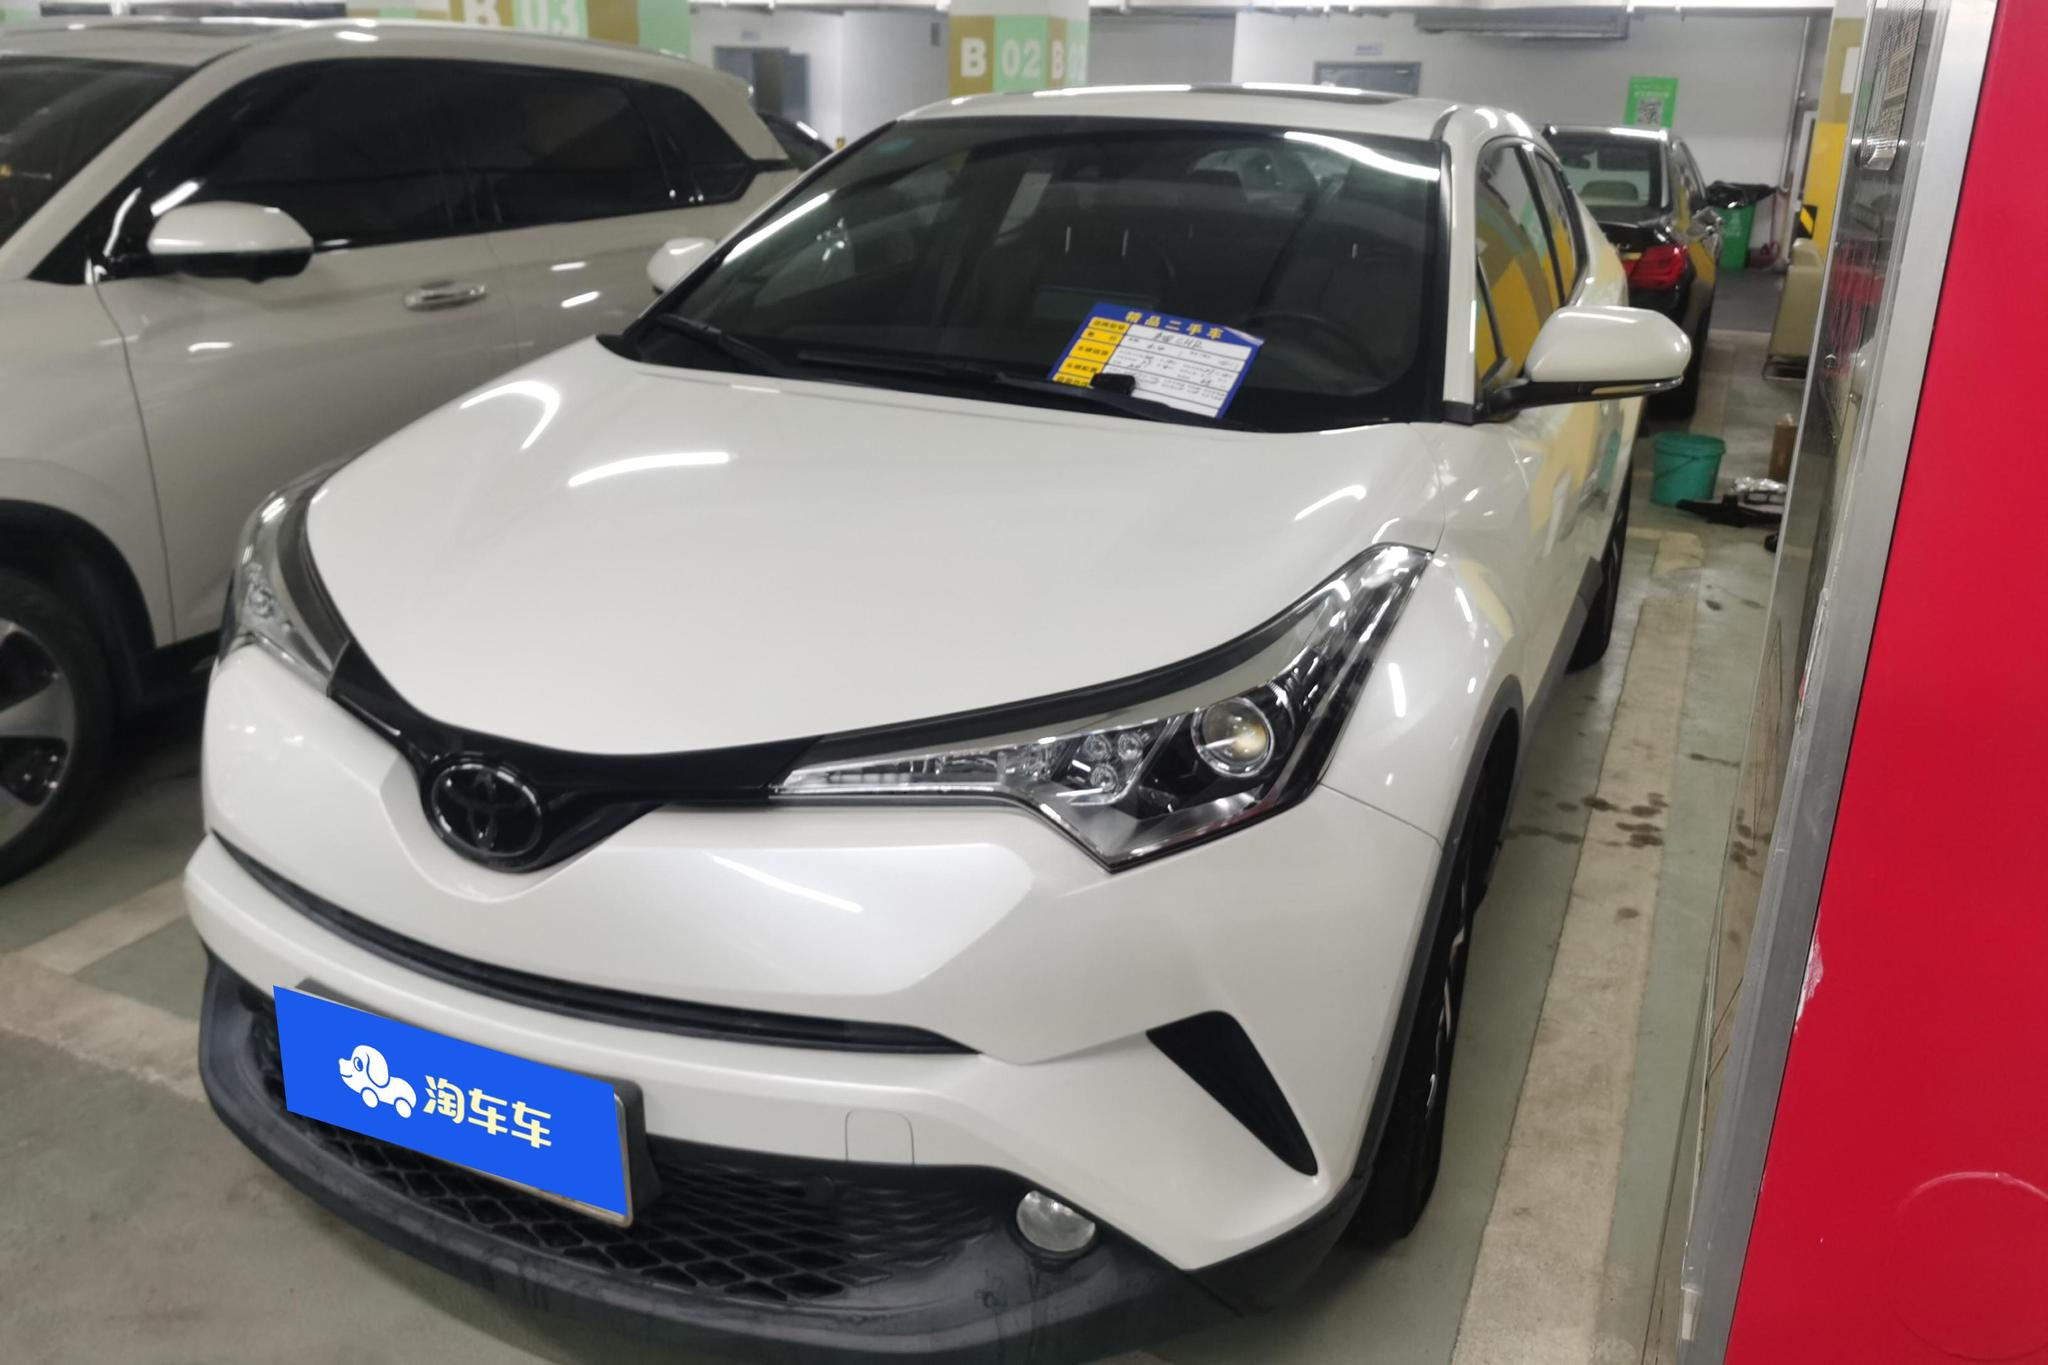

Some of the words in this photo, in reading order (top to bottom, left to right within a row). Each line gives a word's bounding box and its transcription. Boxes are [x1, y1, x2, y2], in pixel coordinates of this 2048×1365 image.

[960, 36, 987, 78] B
[1002, 38, 1041, 79] 02
[1051, 39, 1064, 80] B
